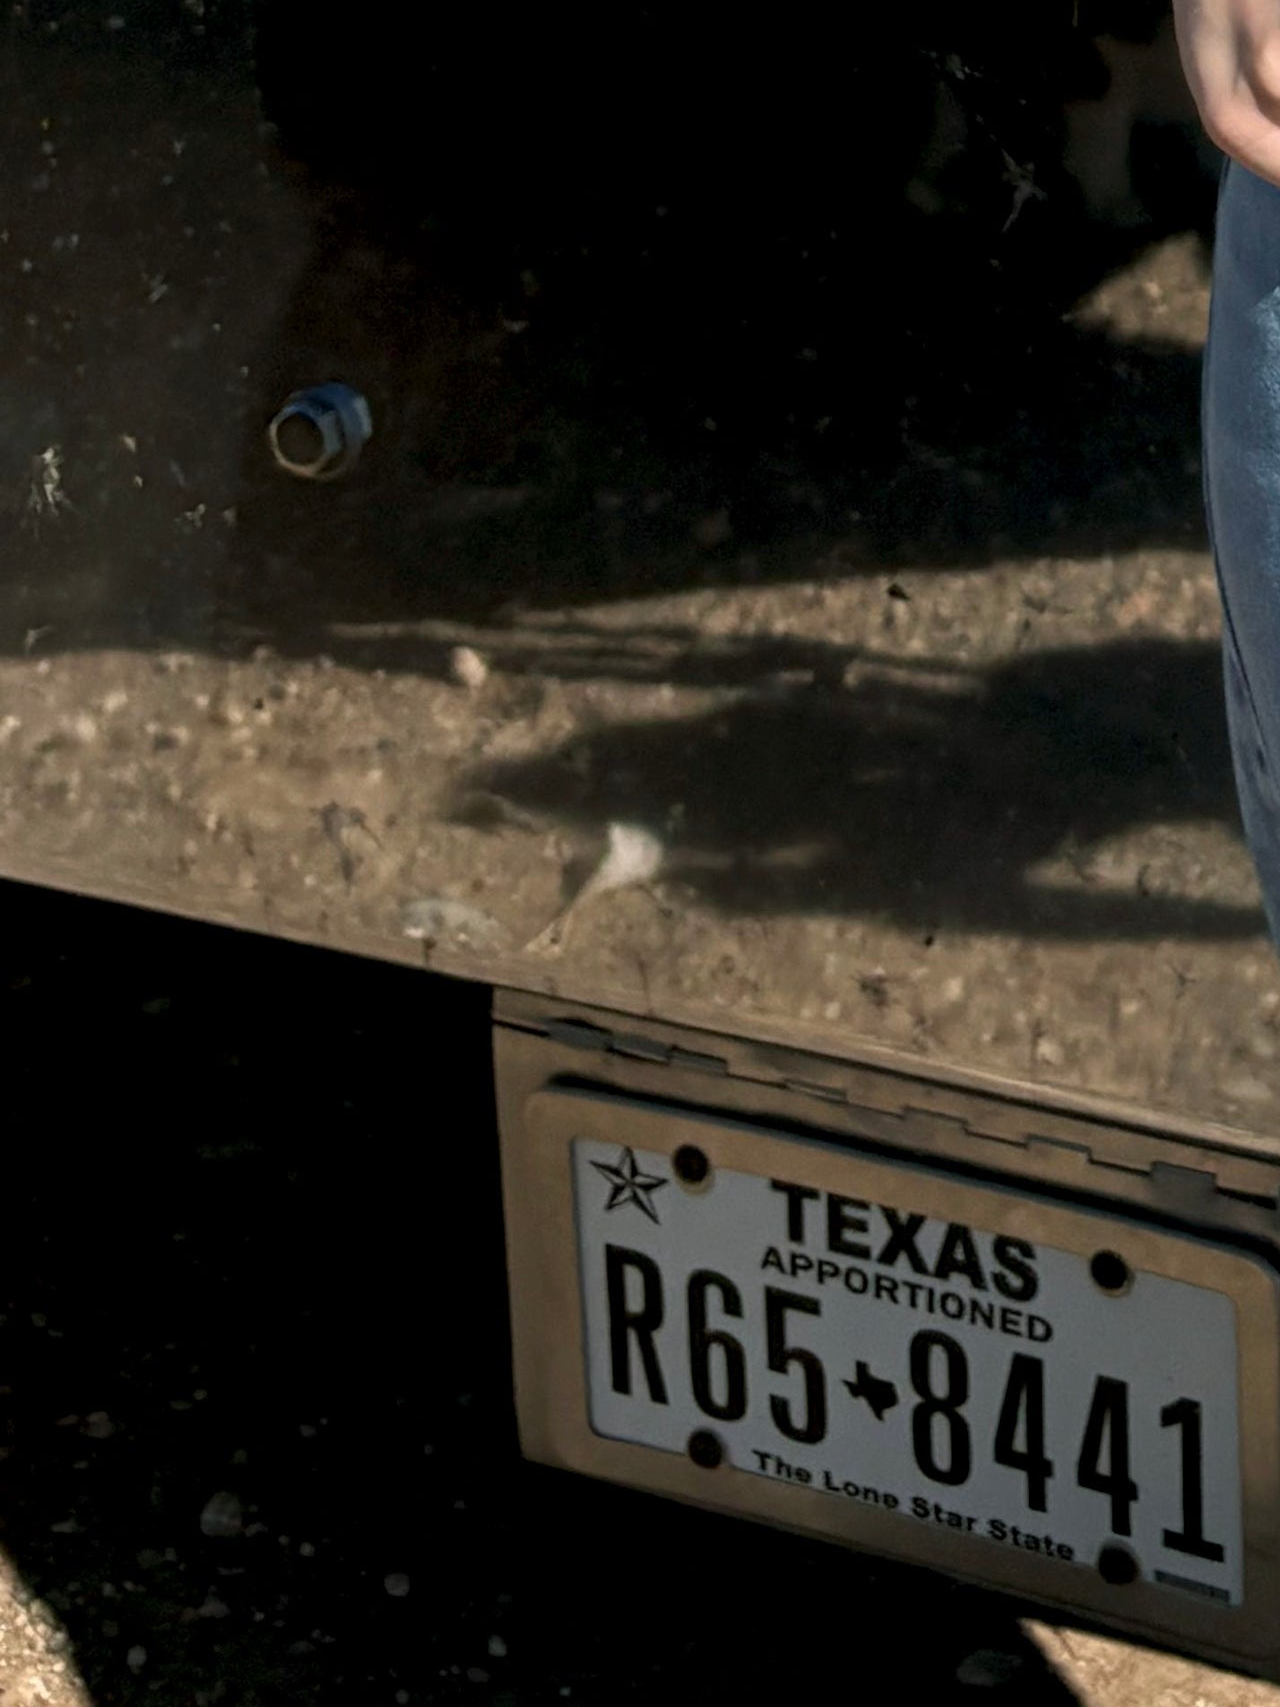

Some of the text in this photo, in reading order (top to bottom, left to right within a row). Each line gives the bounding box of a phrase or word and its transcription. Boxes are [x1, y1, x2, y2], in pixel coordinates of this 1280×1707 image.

[759, 1244, 1055, 1344] APPORTIONED
[768, 1177, 1040, 1304] TEXAS
[751, 1448, 1076, 1563] The Lone Star State
